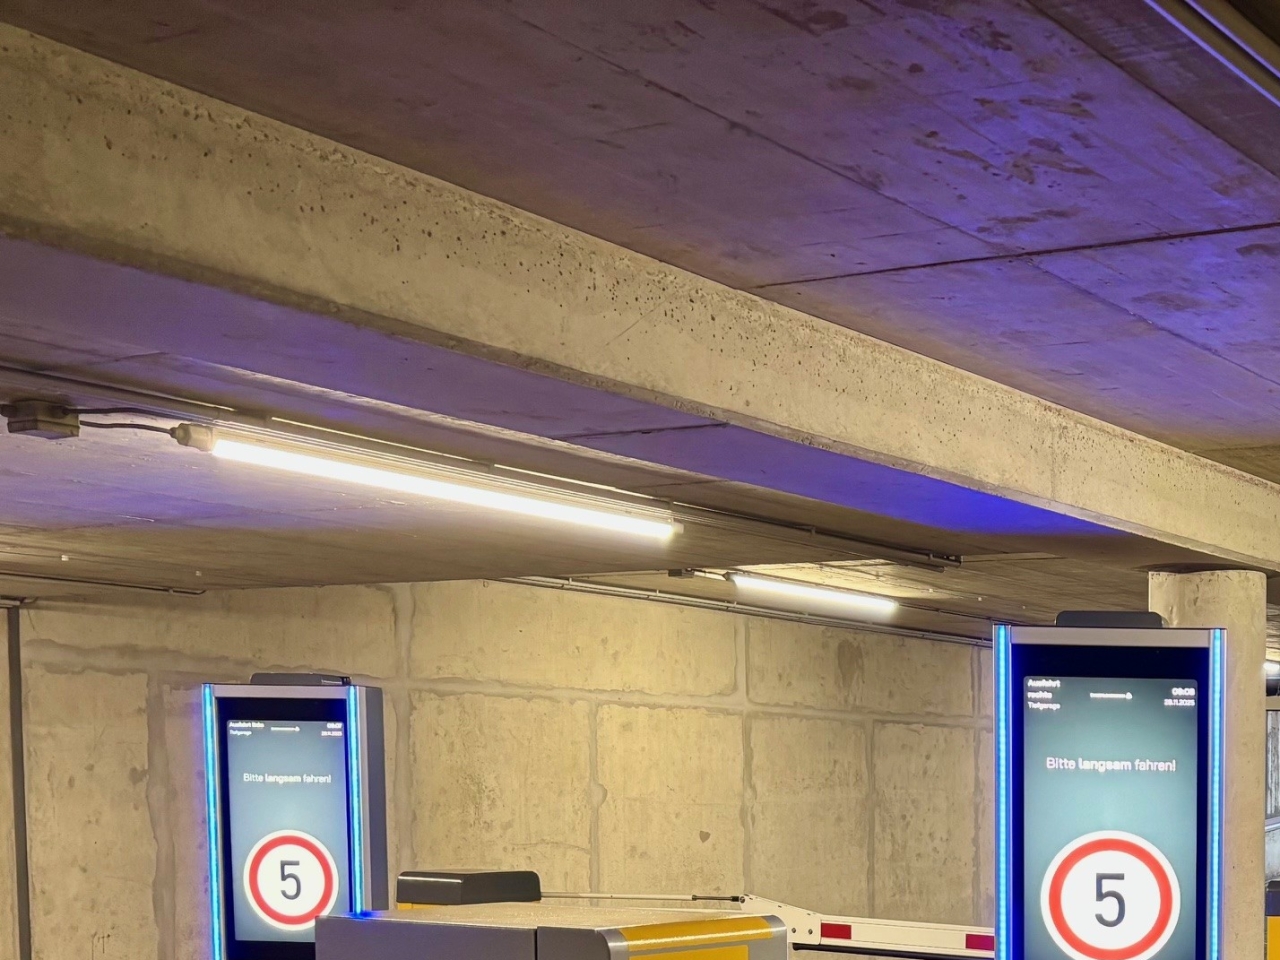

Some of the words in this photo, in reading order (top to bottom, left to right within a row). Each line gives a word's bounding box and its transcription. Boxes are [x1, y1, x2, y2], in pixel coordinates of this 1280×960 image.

[243, 772, 264, 783] Bitte
[264, 773, 302, 785] langsam
[303, 774, 332, 784] fahren!
[1046, 757, 1076, 770] Bitte
[1078, 757, 1132, 773] langsam
[1134, 758, 1176, 772] fahren!
[281, 860, 302, 900] 5
[1095, 872, 1126, 928] 5
